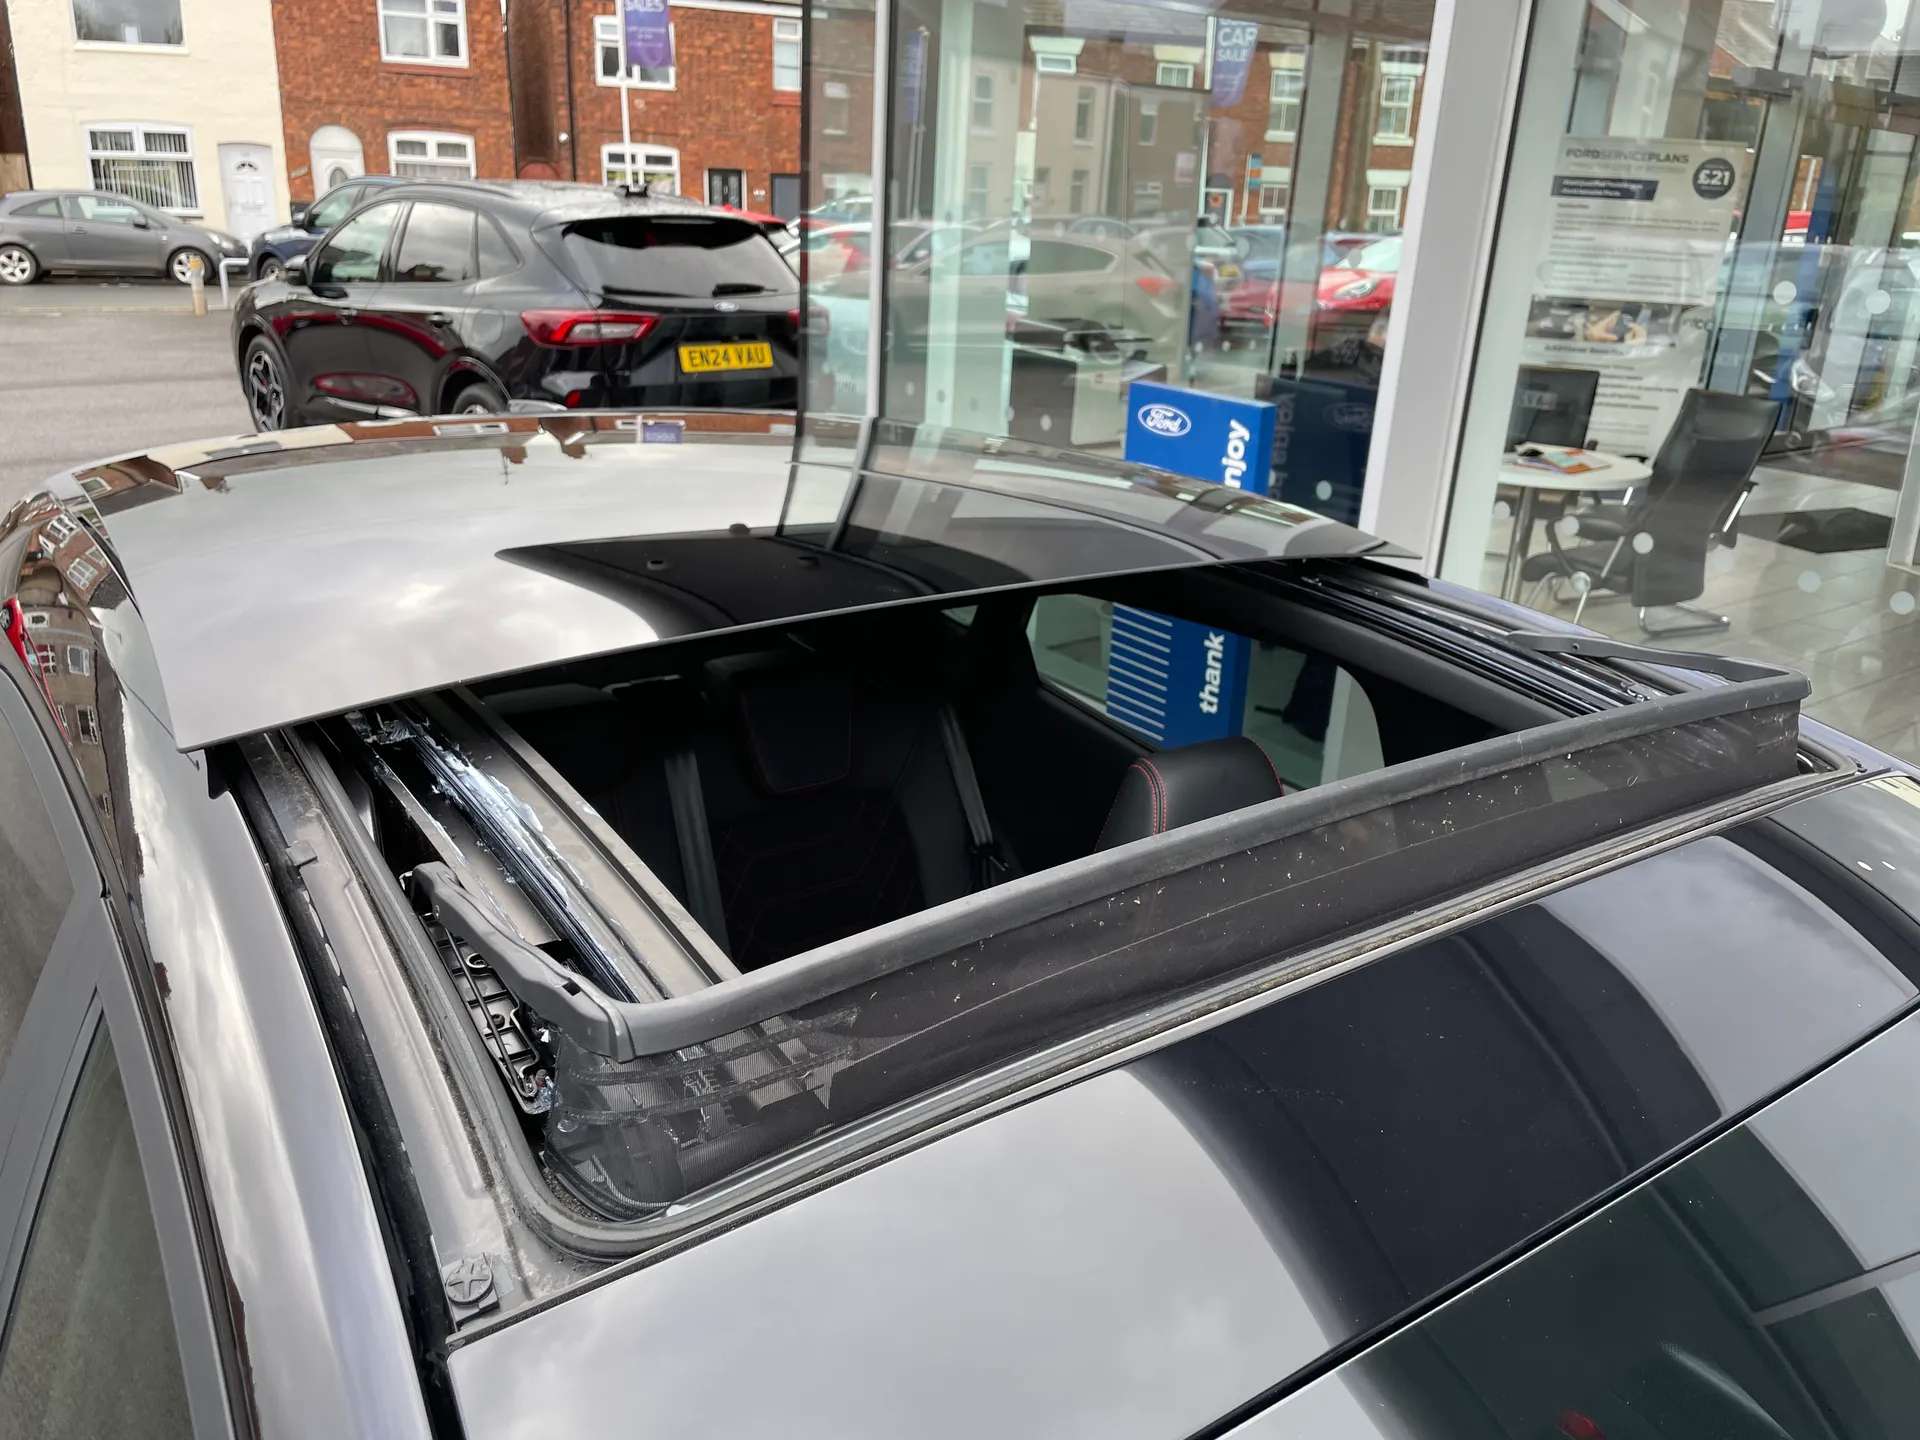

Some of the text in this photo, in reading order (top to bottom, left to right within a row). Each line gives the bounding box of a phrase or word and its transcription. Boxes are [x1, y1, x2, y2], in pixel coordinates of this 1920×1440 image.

[1697, 169, 1730, 186] £21
[688, 345, 766, 368] EN24 VAU
[1146, 408, 1186, 433] Ford
[1222, 419, 1250, 488] njoy
[1199, 632, 1225, 714] thank
